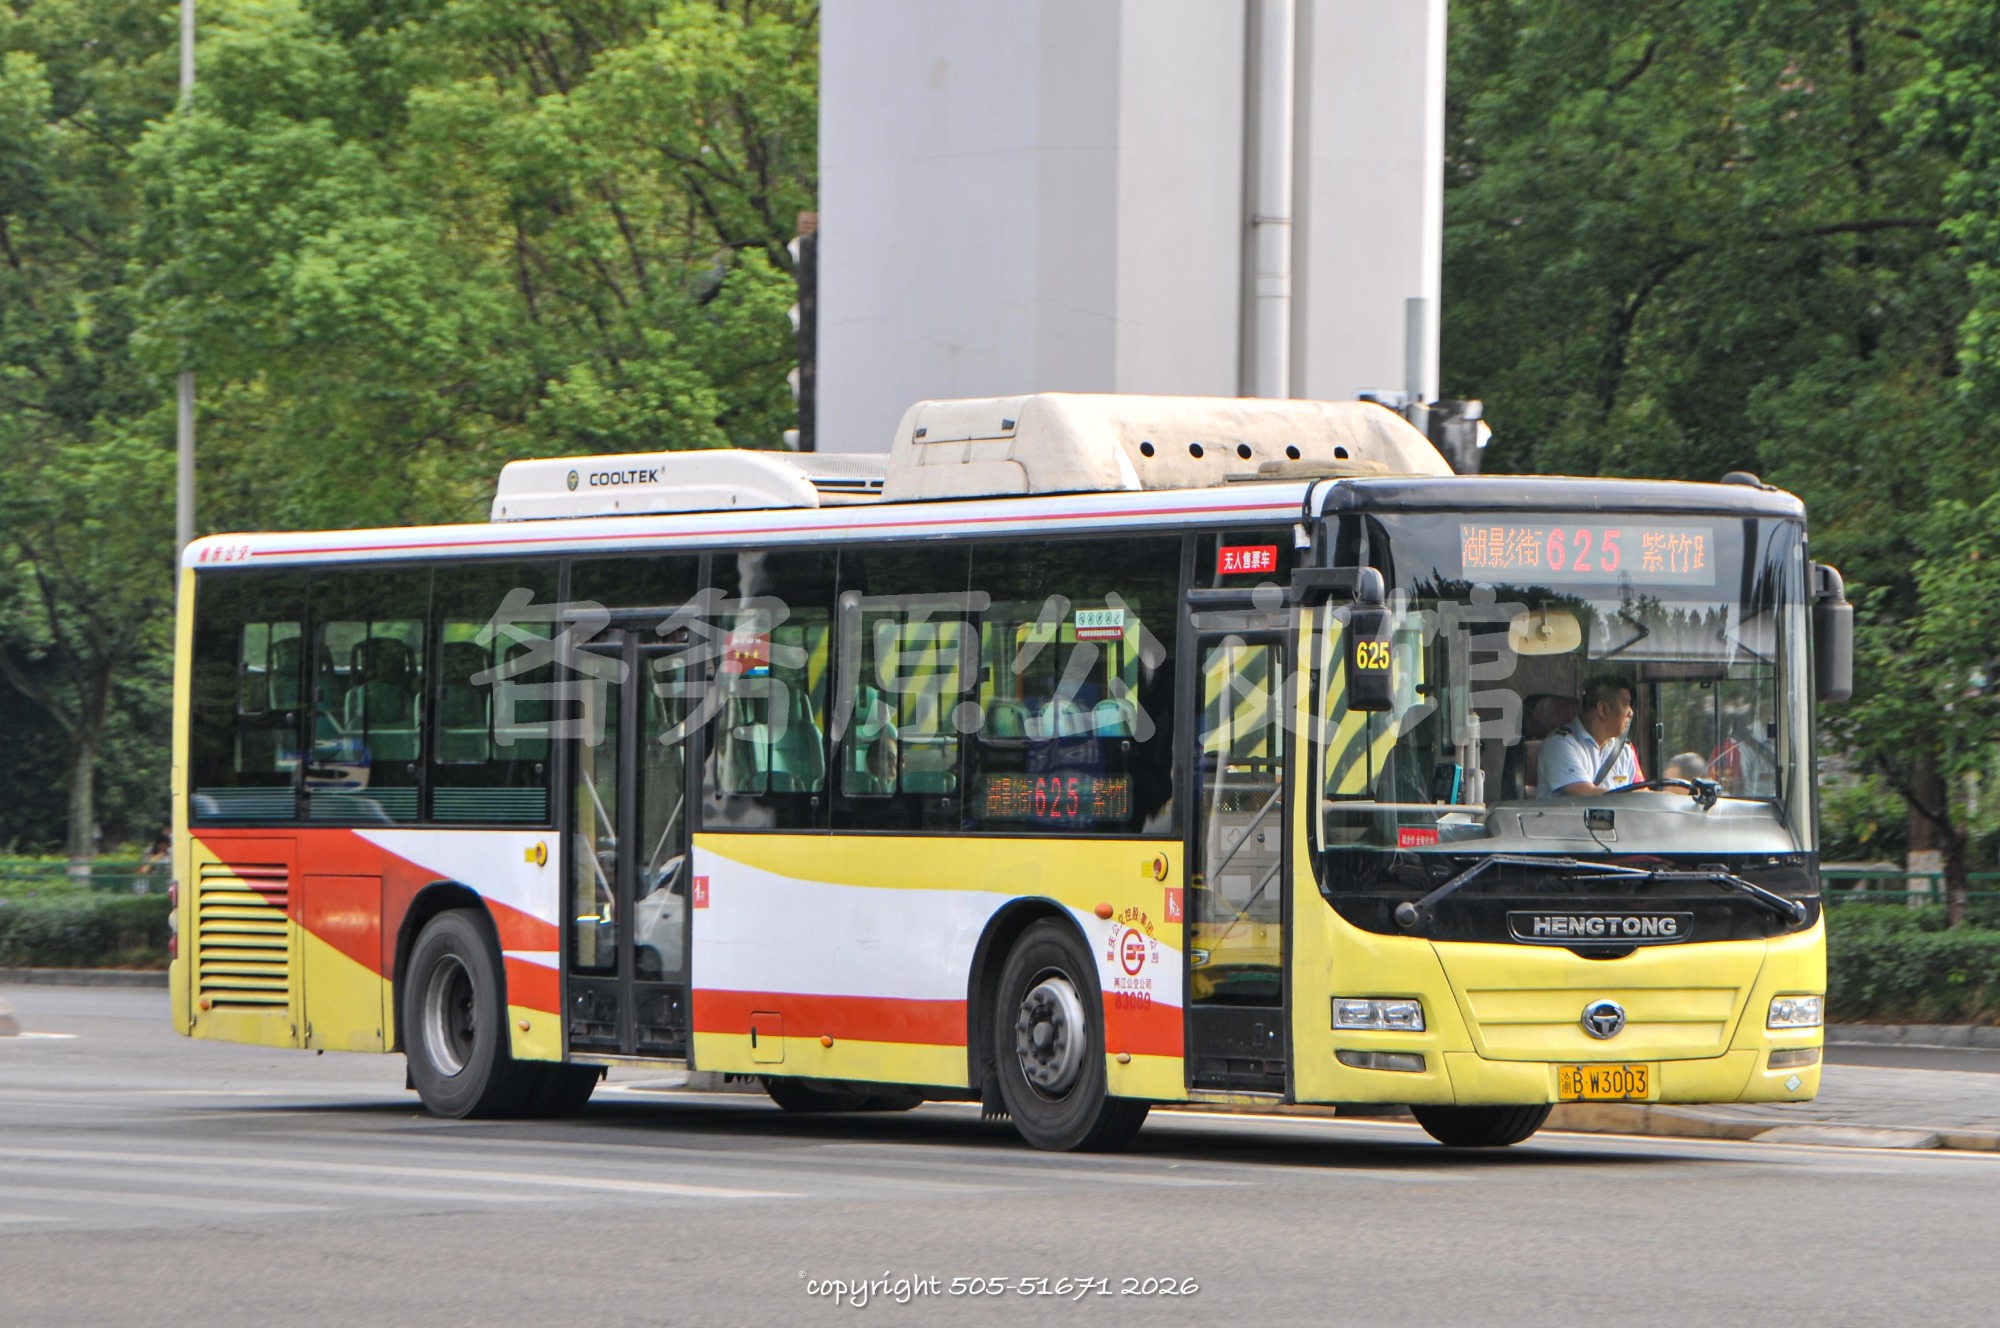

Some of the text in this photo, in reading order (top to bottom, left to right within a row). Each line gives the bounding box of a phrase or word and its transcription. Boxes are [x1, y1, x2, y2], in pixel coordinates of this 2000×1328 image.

[589, 469, 659, 487] COOLTEK
[1224, 549, 1271, 571] 无人售票车
[1462, 527, 1543, 569] 湖影街
[1546, 527, 1621, 572] 625
[1356, 641, 1390, 670] 625
[1035, 777, 1080, 817] 625
[1533, 916, 1678, 936] HENGTONG
[1115, 991, 1151, 1010] 83089
